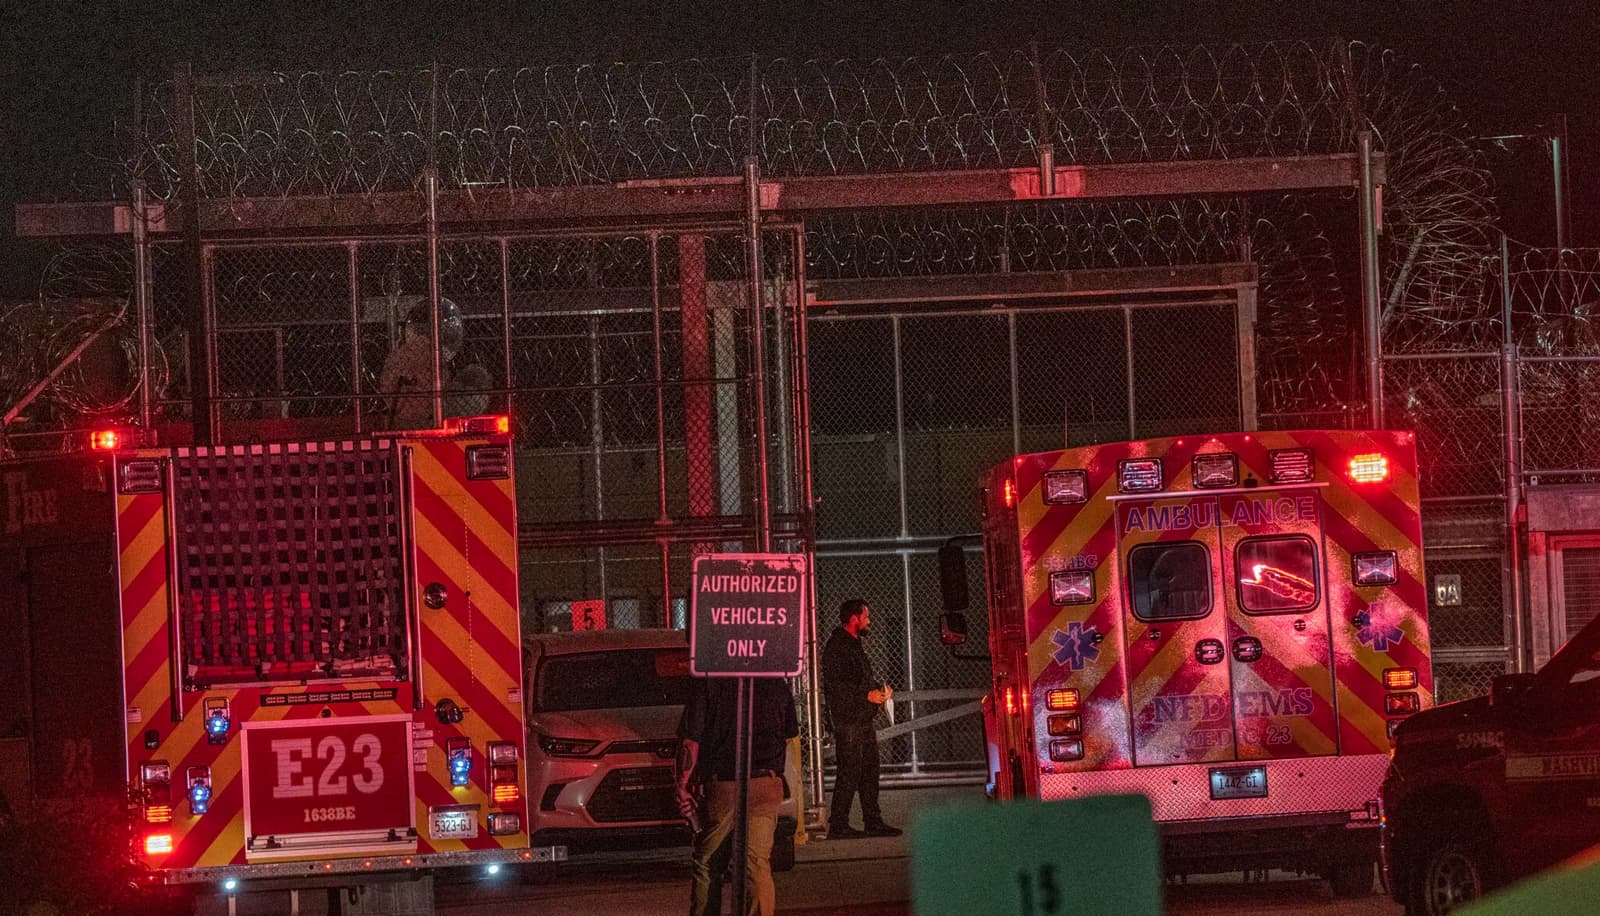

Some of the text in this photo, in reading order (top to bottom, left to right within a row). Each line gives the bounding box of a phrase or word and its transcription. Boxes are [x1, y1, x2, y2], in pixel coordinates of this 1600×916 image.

[1124, 496, 1316, 534] AMBULANCE
[701, 575, 798, 593] AUTHORIZED
[584, 607, 596, 631] 5
[711, 607, 787, 625] VEHICLES
[727, 639, 767, 657] ONLY
[1149, 687, 1315, 724] NFD EMS
[1266, 725, 1293, 745] 23
[271, 733, 385, 799] E23
[1542, 757, 1600, 775] NASHVI
[303, 805, 357, 823] 1638BE
[435, 818, 472, 833] 5323-GJ
